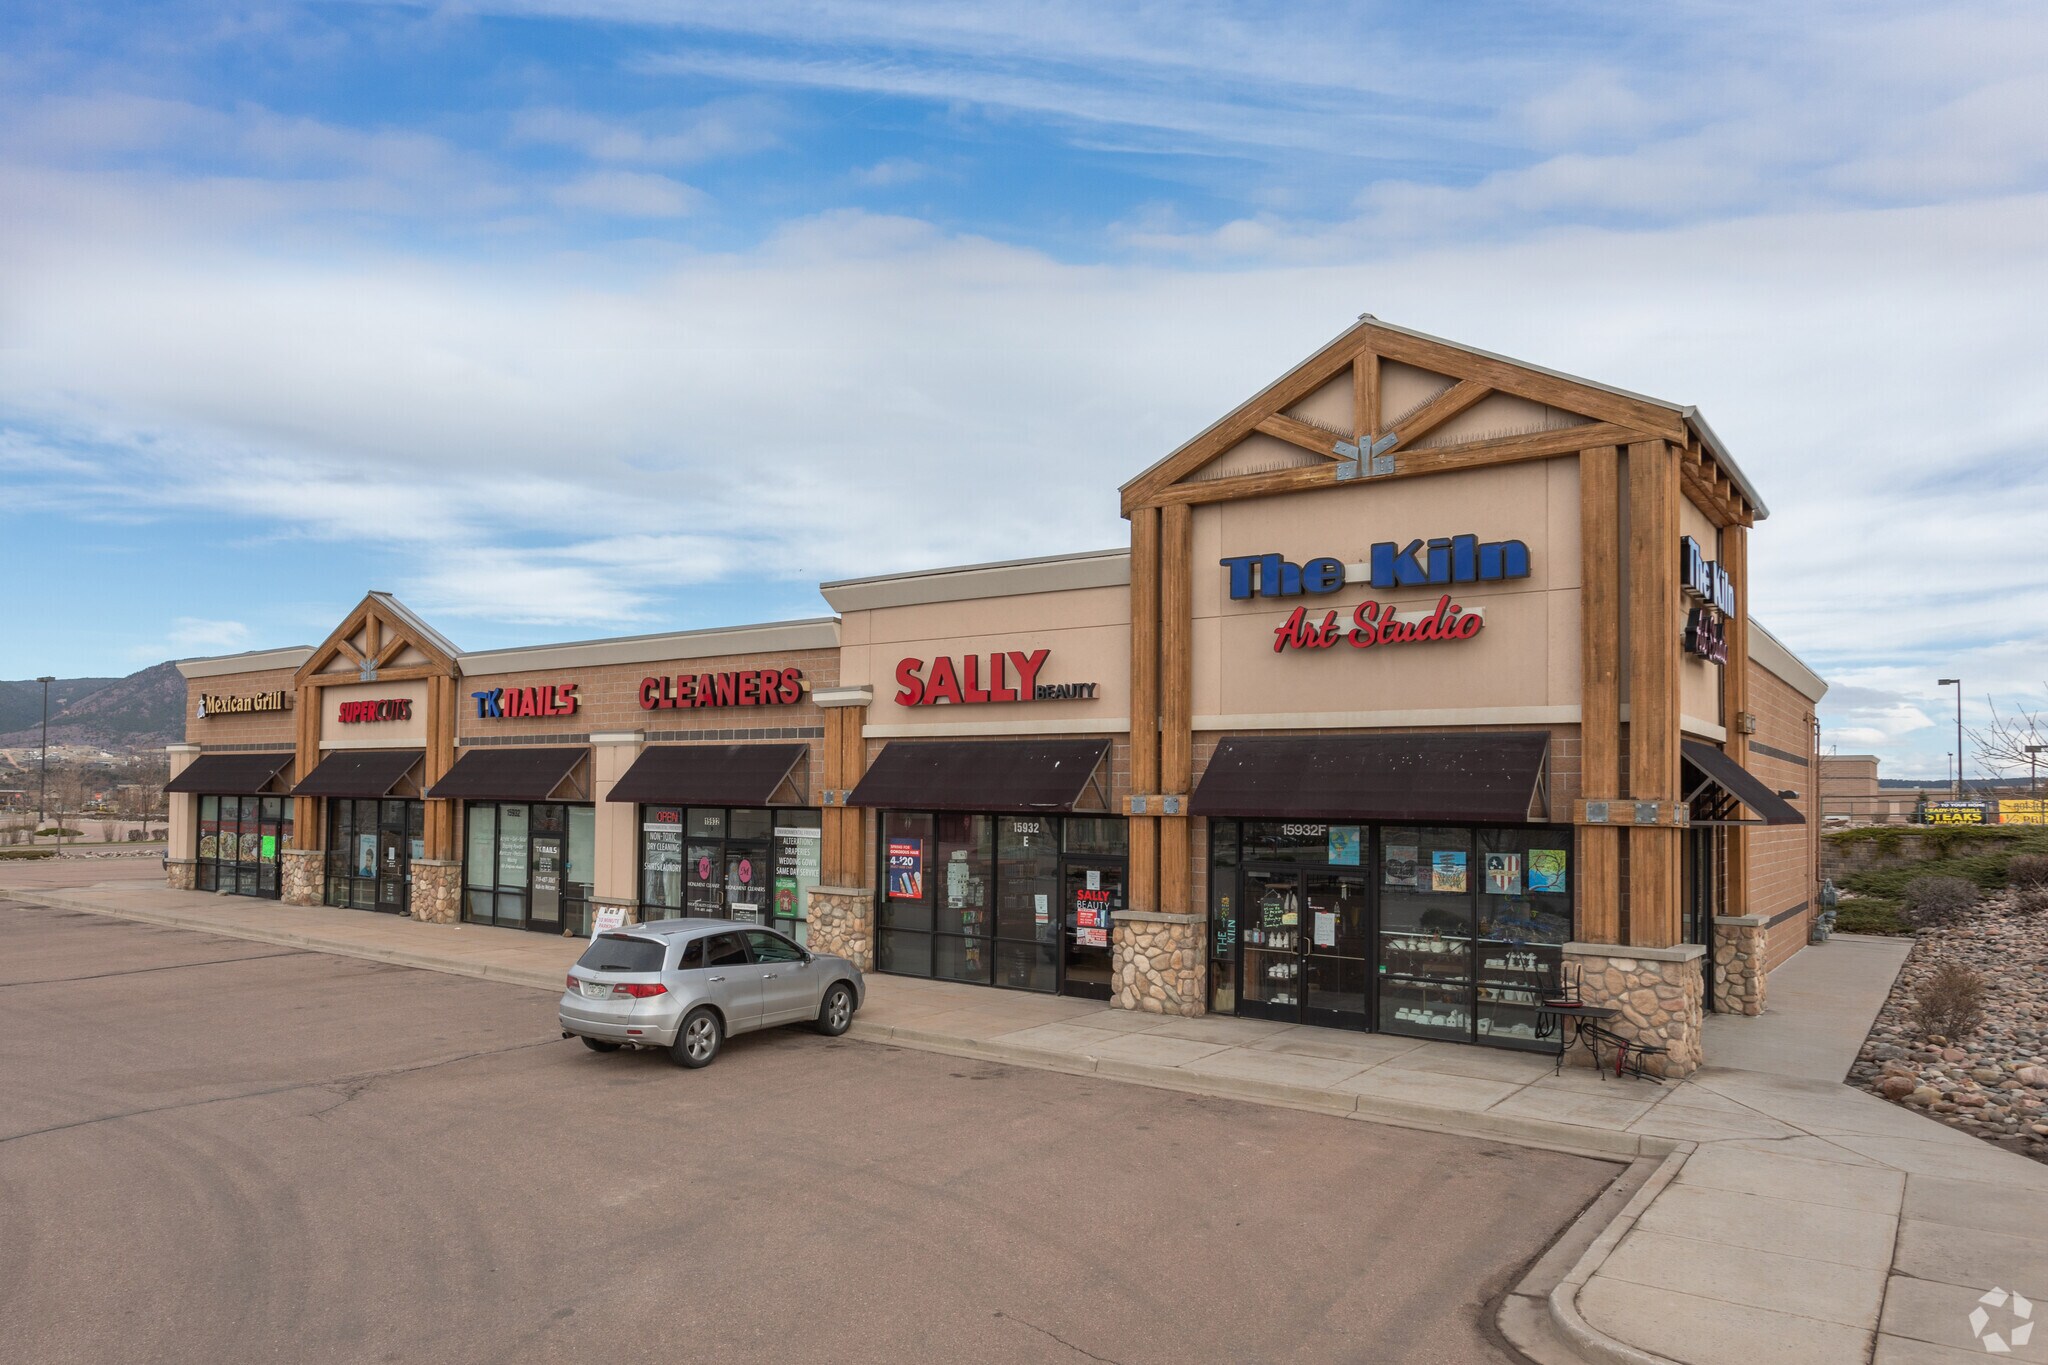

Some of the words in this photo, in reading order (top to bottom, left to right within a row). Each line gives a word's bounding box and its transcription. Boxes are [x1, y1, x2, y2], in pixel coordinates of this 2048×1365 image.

[1220, 553, 1345, 600] The
[1370, 534, 1532, 589] Kiln
[1685, 535, 1711, 600] The
[1713, 560, 1735, 619] Kiln
[1273, 605, 1340, 653] Art
[1348, 594, 1484, 649] Studio
[894, 649, 1051, 707] SALLY
[1036, 682, 1099, 701] BEAUTY
[639, 667, 803, 711] CLEANERS
[205, 695, 252, 714] Mexican
[253, 690, 284, 711] Grill
[471, 687, 502, 719] TK
[503, 684, 578, 718] NAILS
[338, 699, 412, 723] SUPERCUTS
[656, 811, 679, 823] OPEN
[1925, 813, 1982, 821] STEAKS
[1013, 822, 1040, 833] 15932
[1281, 824, 1327, 836] 15932F
[650, 832, 677, 841] NON-TOXIC
[783, 837, 814, 846] ALTERATIONS
[1023, 836, 1029, 847] E
[647, 842, 657, 851] DRY
[657, 843, 680, 852] CLEANING
[785, 847, 811, 856] DRAPERIES
[660, 853, 666, 861] &
[778, 857, 801, 866] WEDDING
[801, 858, 817, 866] GOWN
[660, 863, 682, 872] LAUNDRY
[776, 867, 790, 875] SAME
[790, 868, 800, 876] DAY
[800, 869, 820, 878] SERVICE
[1077, 889, 1110, 902] SALLY
[1077, 900, 1110, 910] BEAUTY
[1226, 919, 1236, 944] KILN
[1217, 930, 1228, 954] THE
